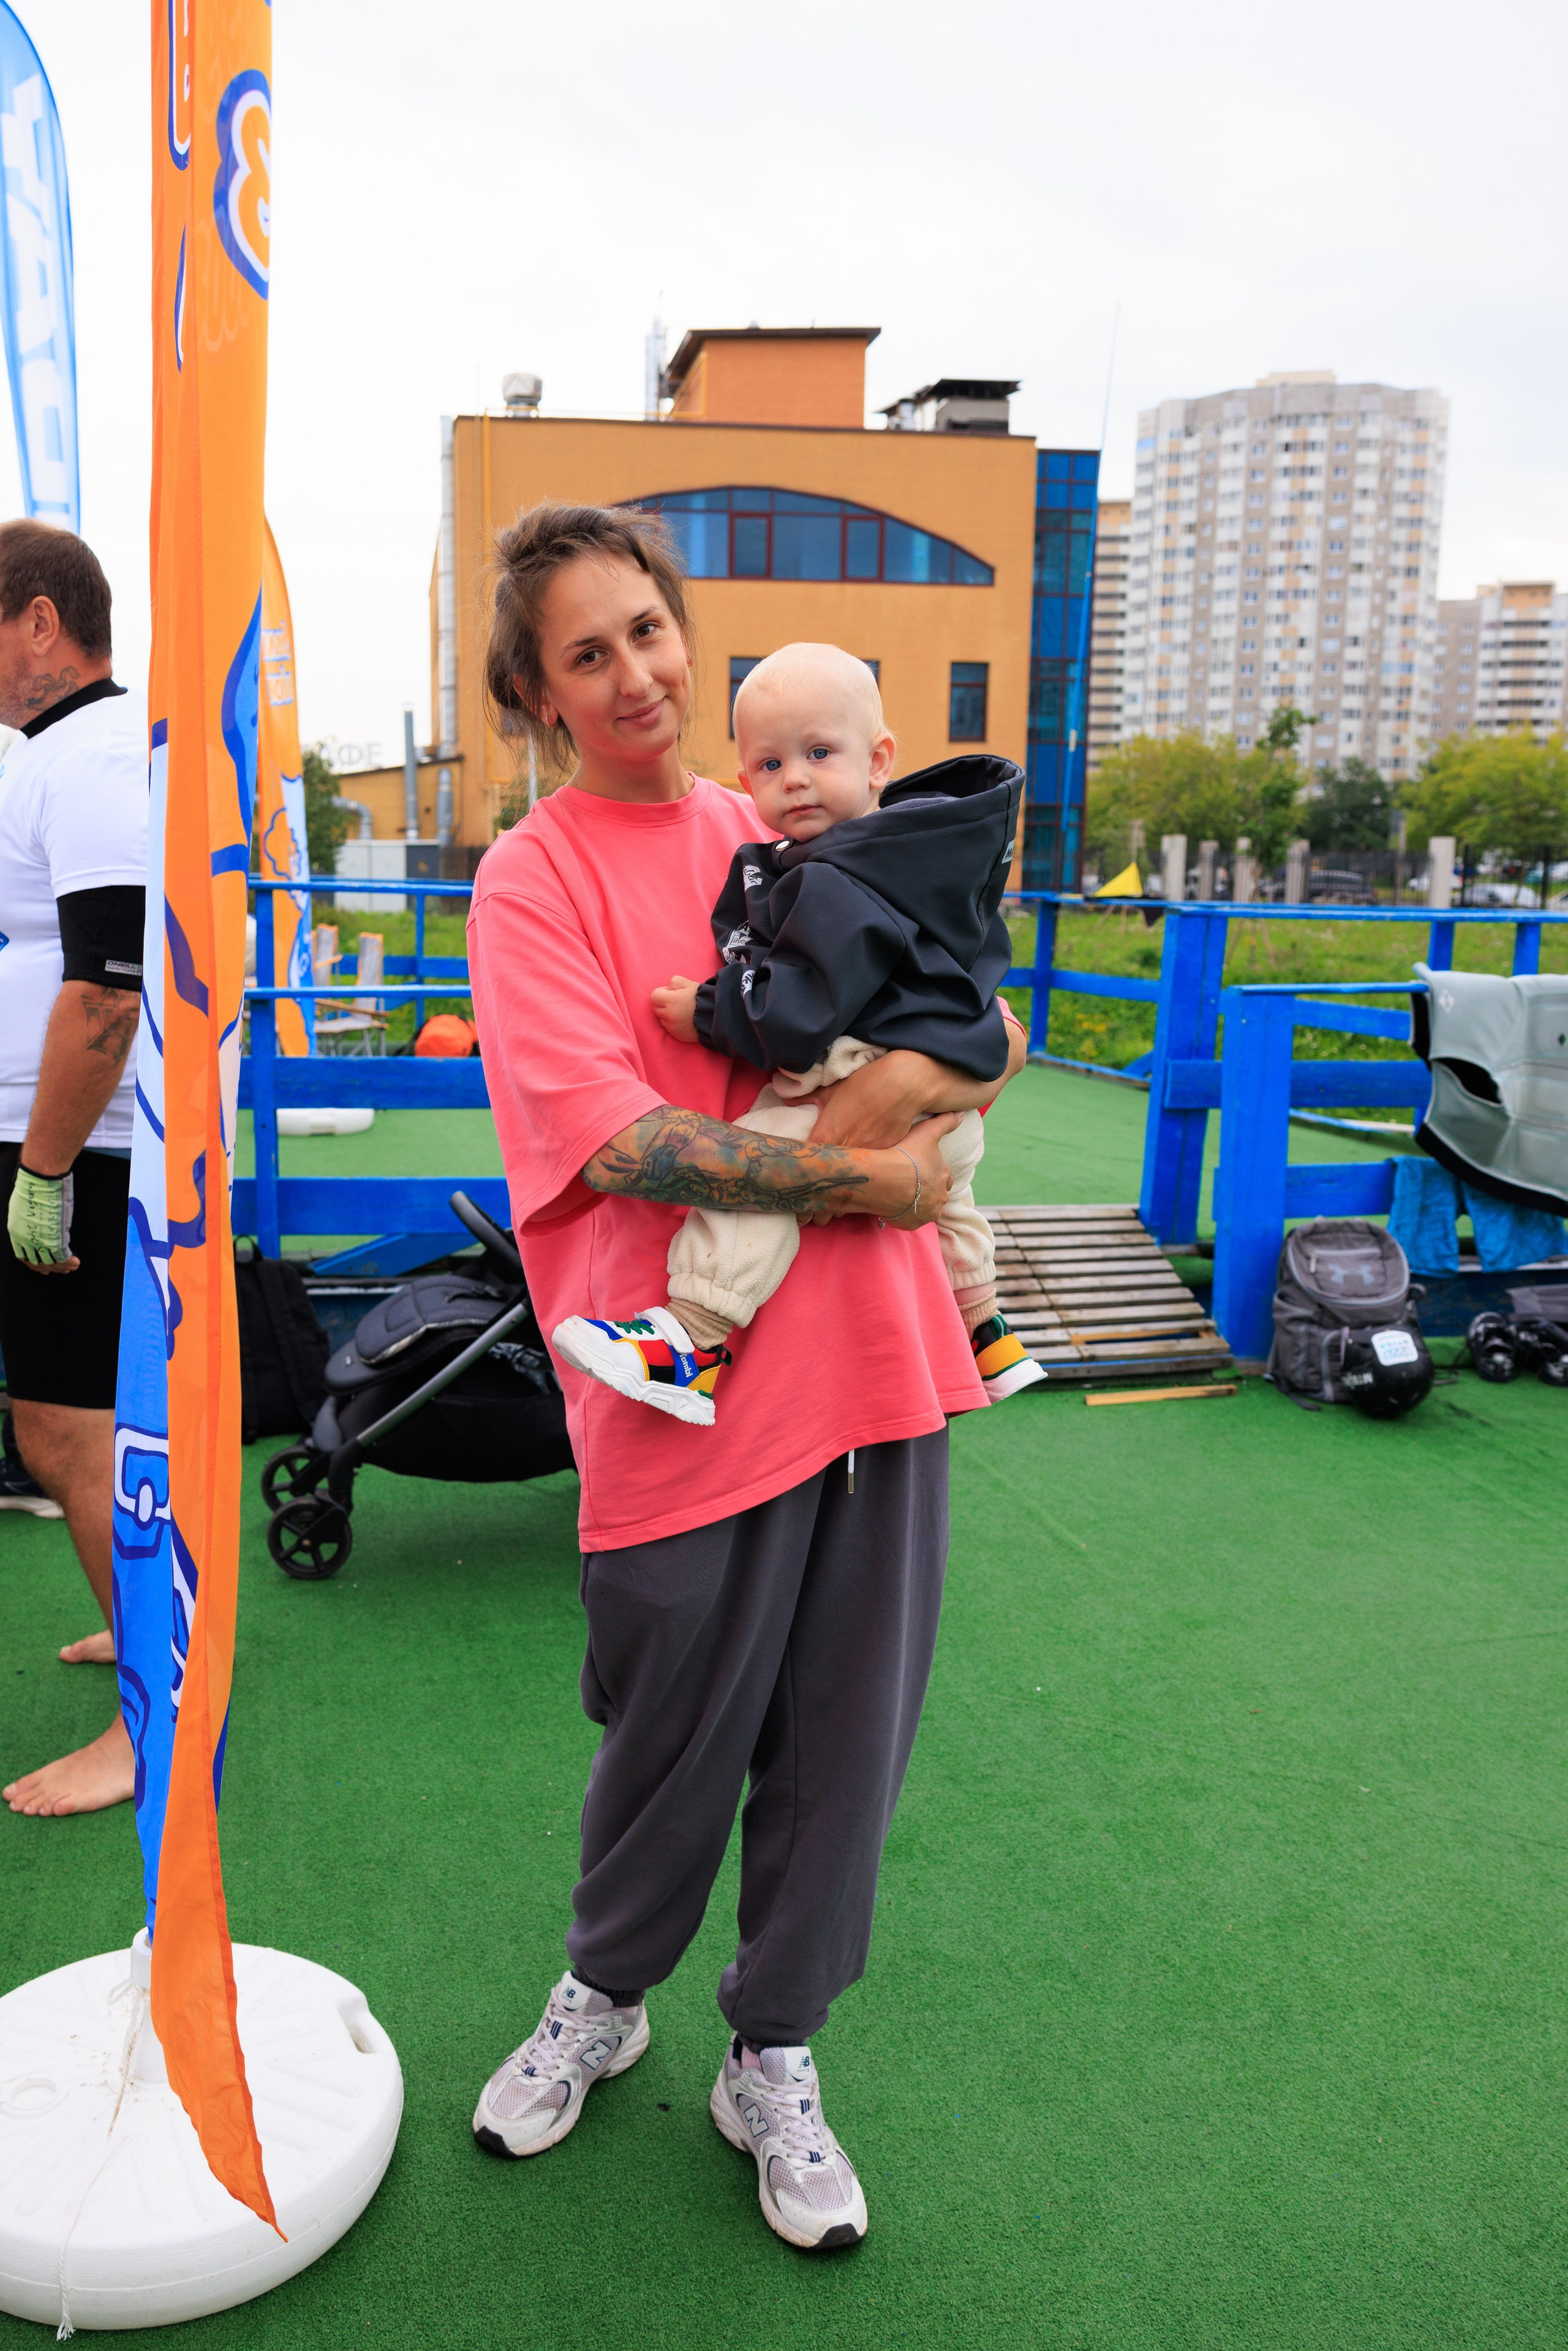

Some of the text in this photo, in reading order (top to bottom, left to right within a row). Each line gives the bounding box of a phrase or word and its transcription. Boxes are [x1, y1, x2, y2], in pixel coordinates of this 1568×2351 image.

[303, 742, 382, 767] АФЕ
[580, 2040, 612, 2070] N
[744, 2103, 769, 2138] N
